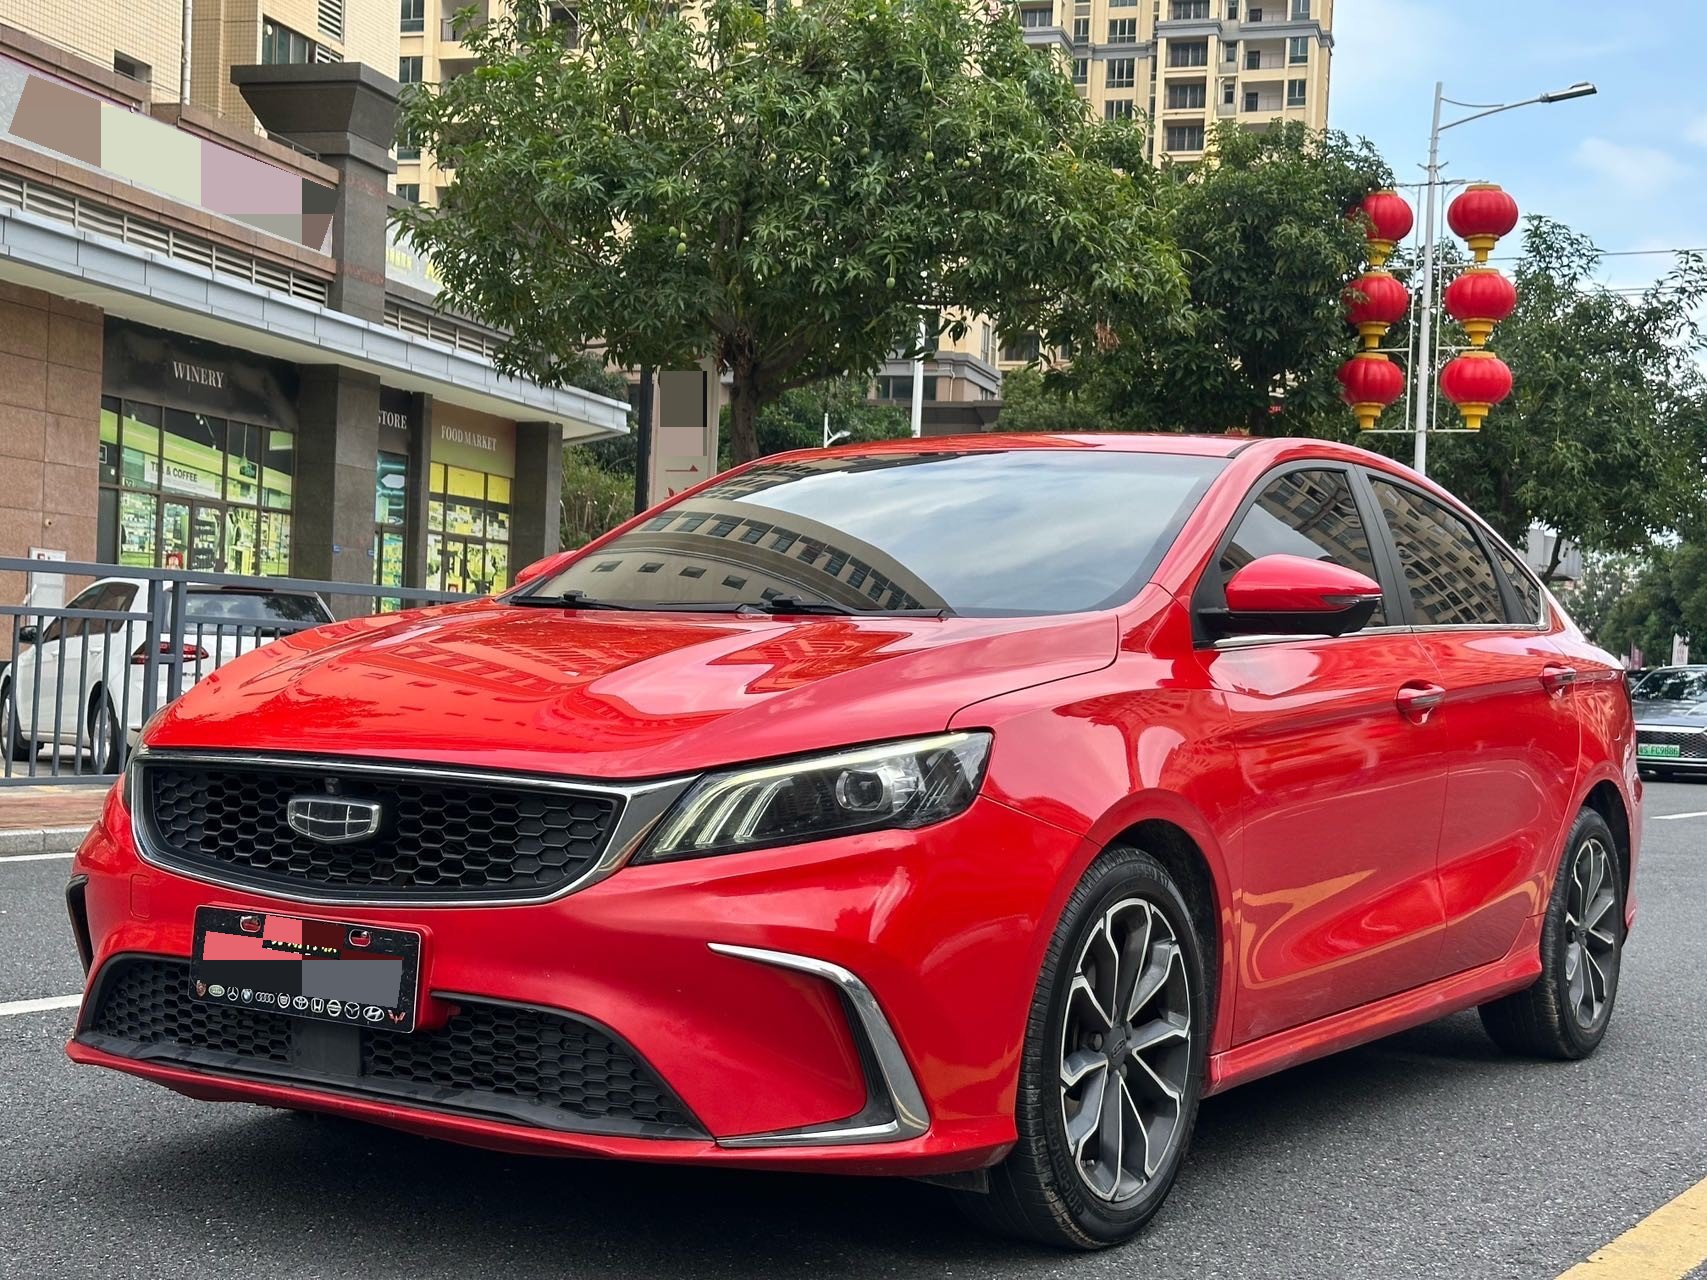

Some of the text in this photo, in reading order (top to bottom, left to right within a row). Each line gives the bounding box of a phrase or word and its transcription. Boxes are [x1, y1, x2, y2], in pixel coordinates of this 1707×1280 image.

[173, 361, 224, 388] WINERY
[441, 425, 497, 451] FOOD MARKET
[166, 466, 171, 475] &
[173, 468, 197, 482] COFFEE
